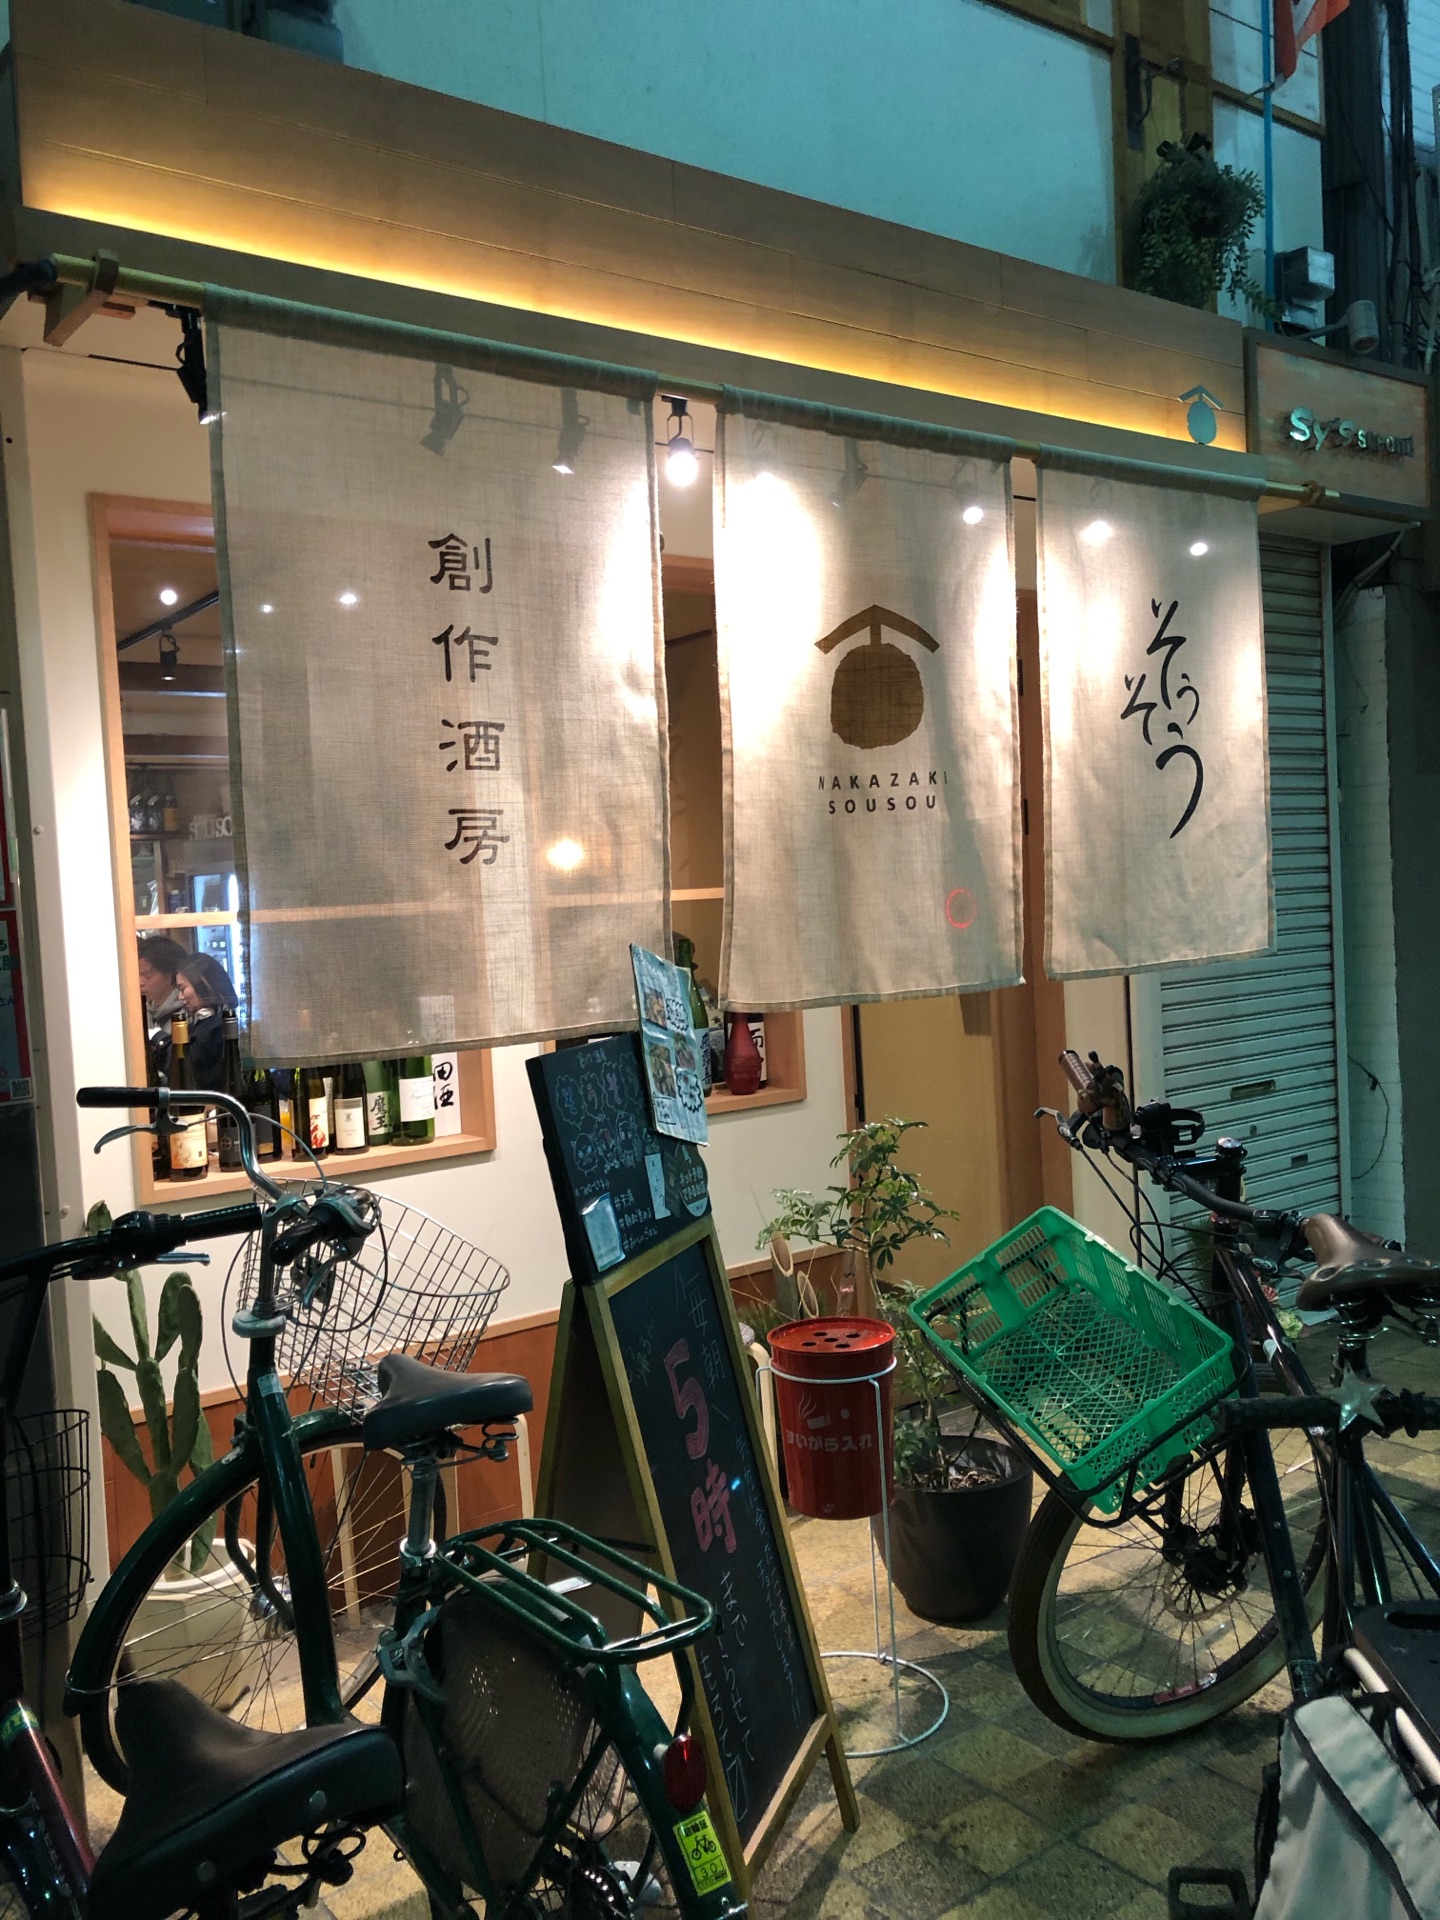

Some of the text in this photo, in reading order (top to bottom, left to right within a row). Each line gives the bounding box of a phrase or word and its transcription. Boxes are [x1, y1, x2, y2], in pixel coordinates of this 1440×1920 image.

[427, 531, 511, 865] 創作酒房
[817, 769, 949, 791] NAKAZAKI
[827, 793, 939, 815] SOUSOU
[370, 1095, 389, 1131] 魔王
[678, 1271, 726, 1392] 毎朝
[663, 1337, 737, 1554] 5時
[785, 1429, 873, 1452] すいがら入れ
